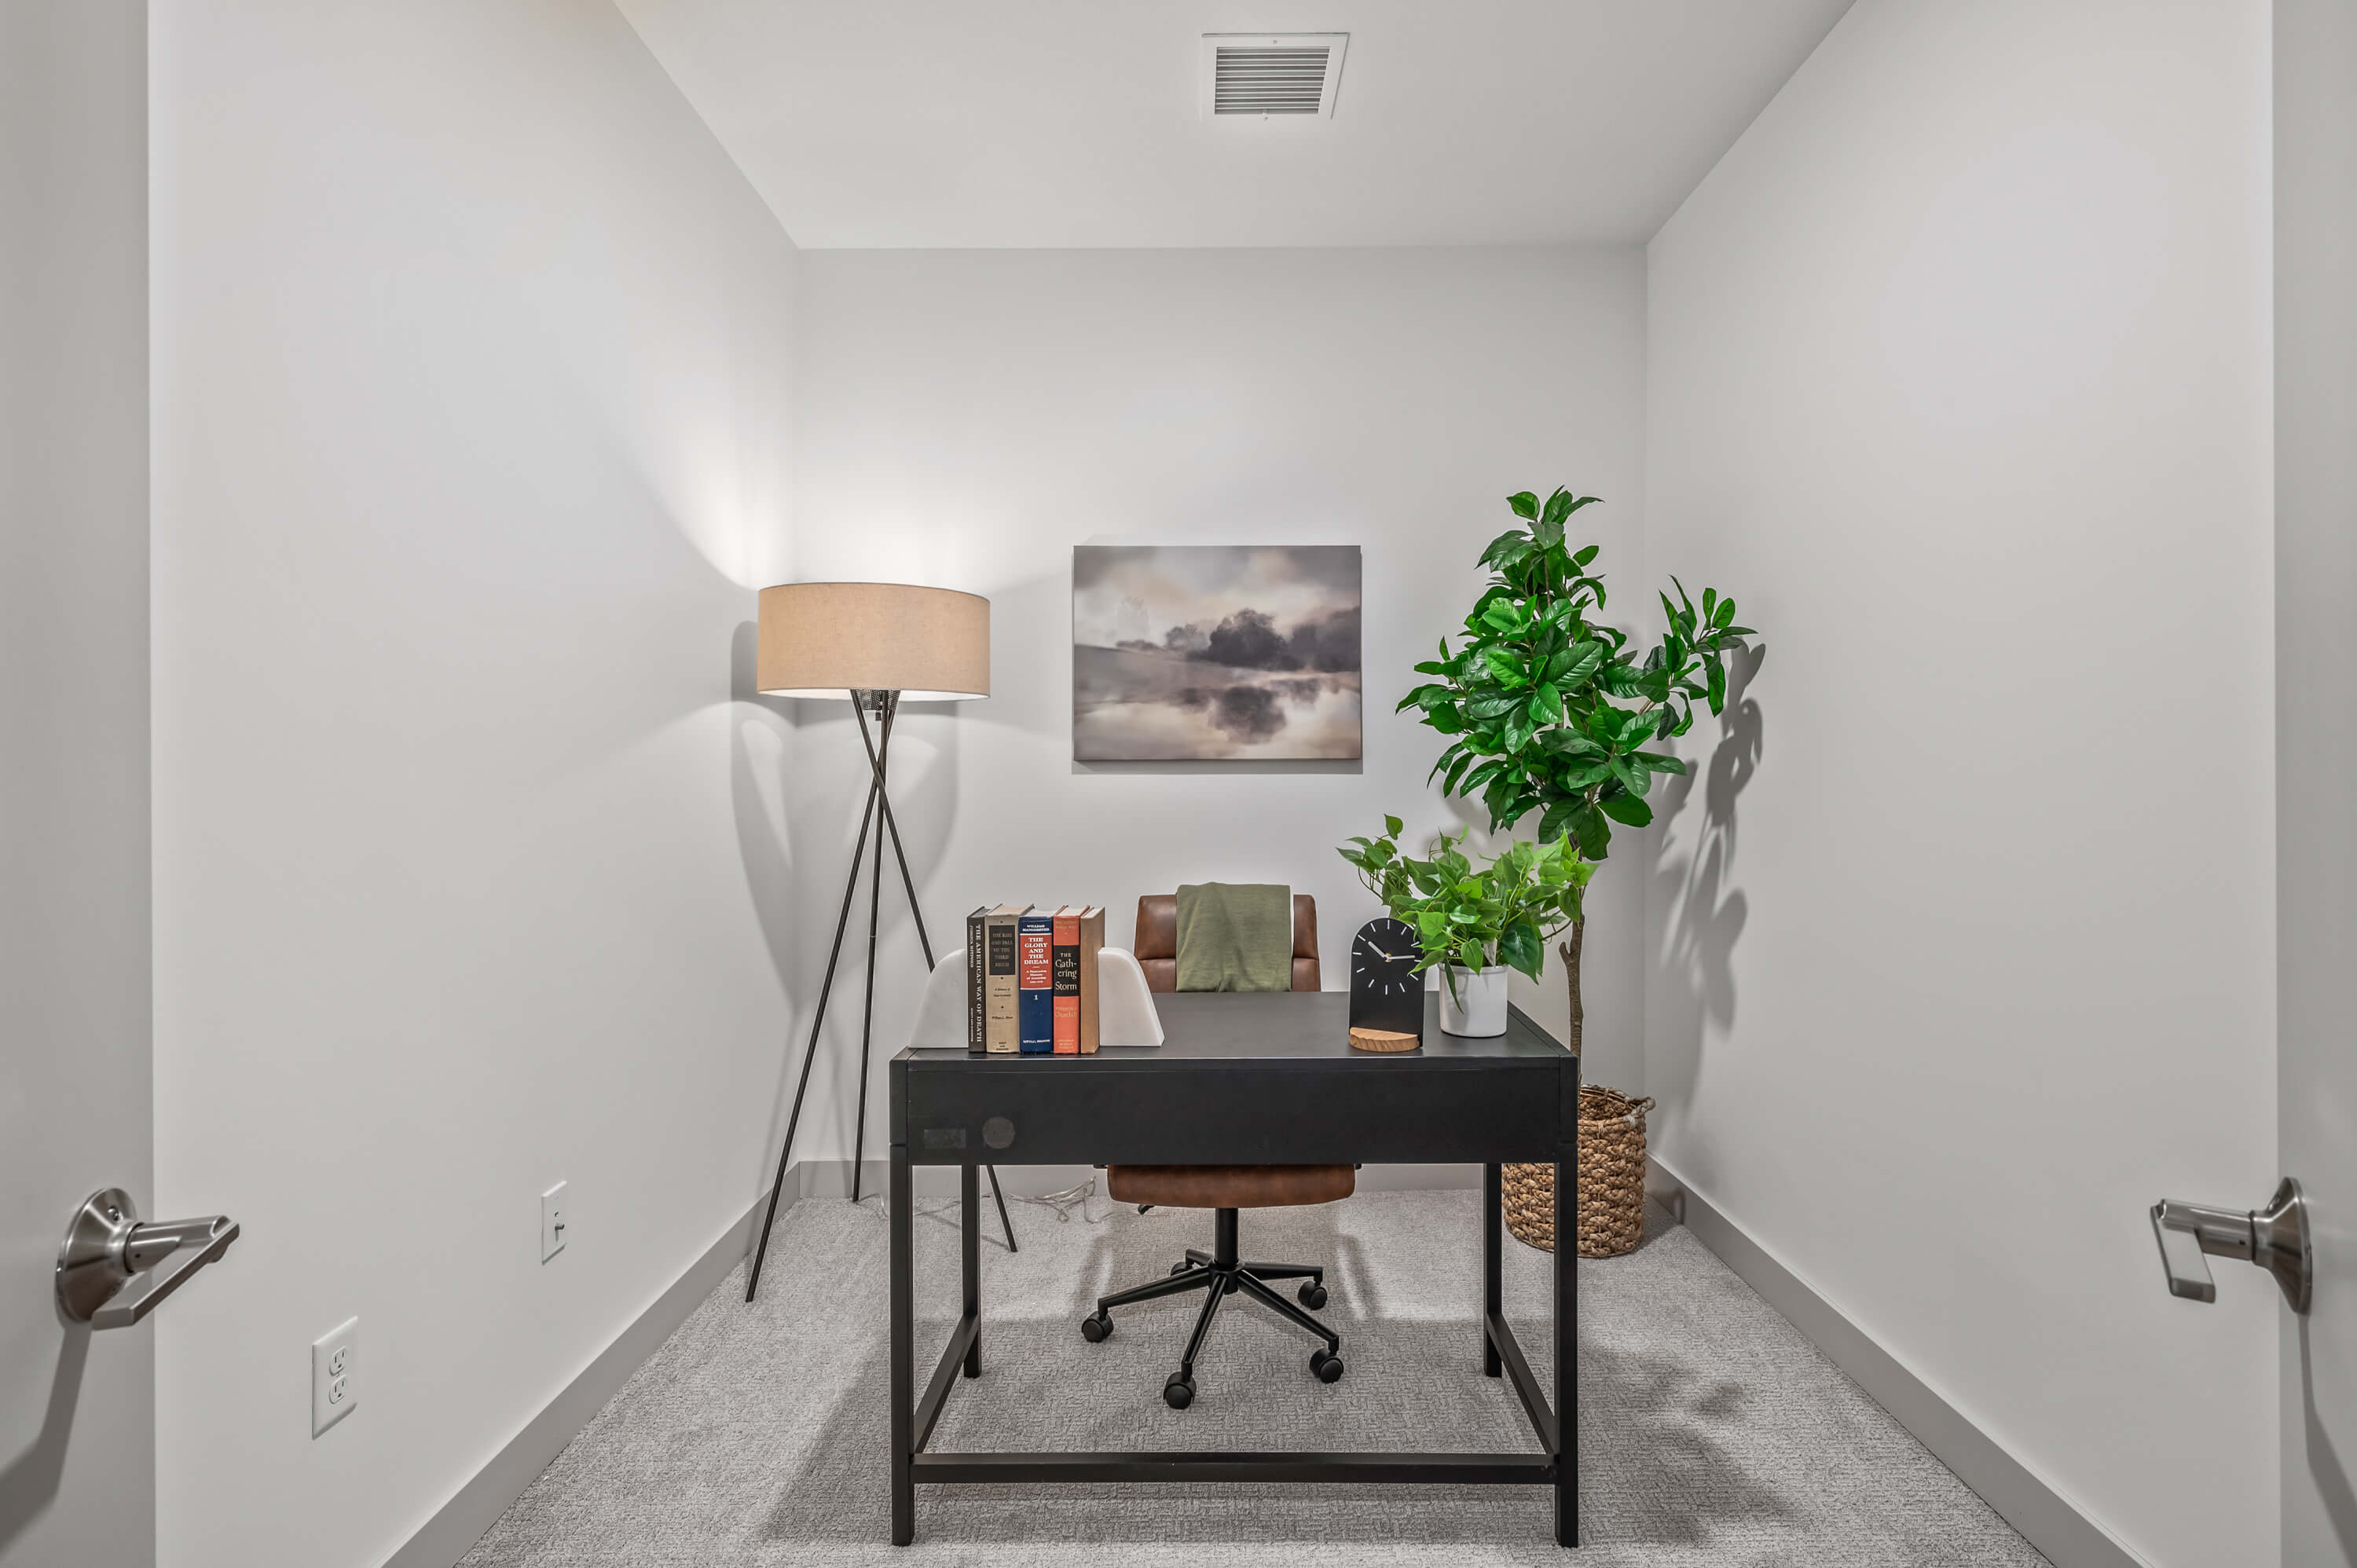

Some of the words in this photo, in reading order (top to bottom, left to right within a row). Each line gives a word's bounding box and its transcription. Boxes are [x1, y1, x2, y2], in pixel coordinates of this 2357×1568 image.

[1055, 958, 1077, 969] Gath-
[1055, 981, 1077, 991] Storm
[976, 1003, 981, 1014] OF
